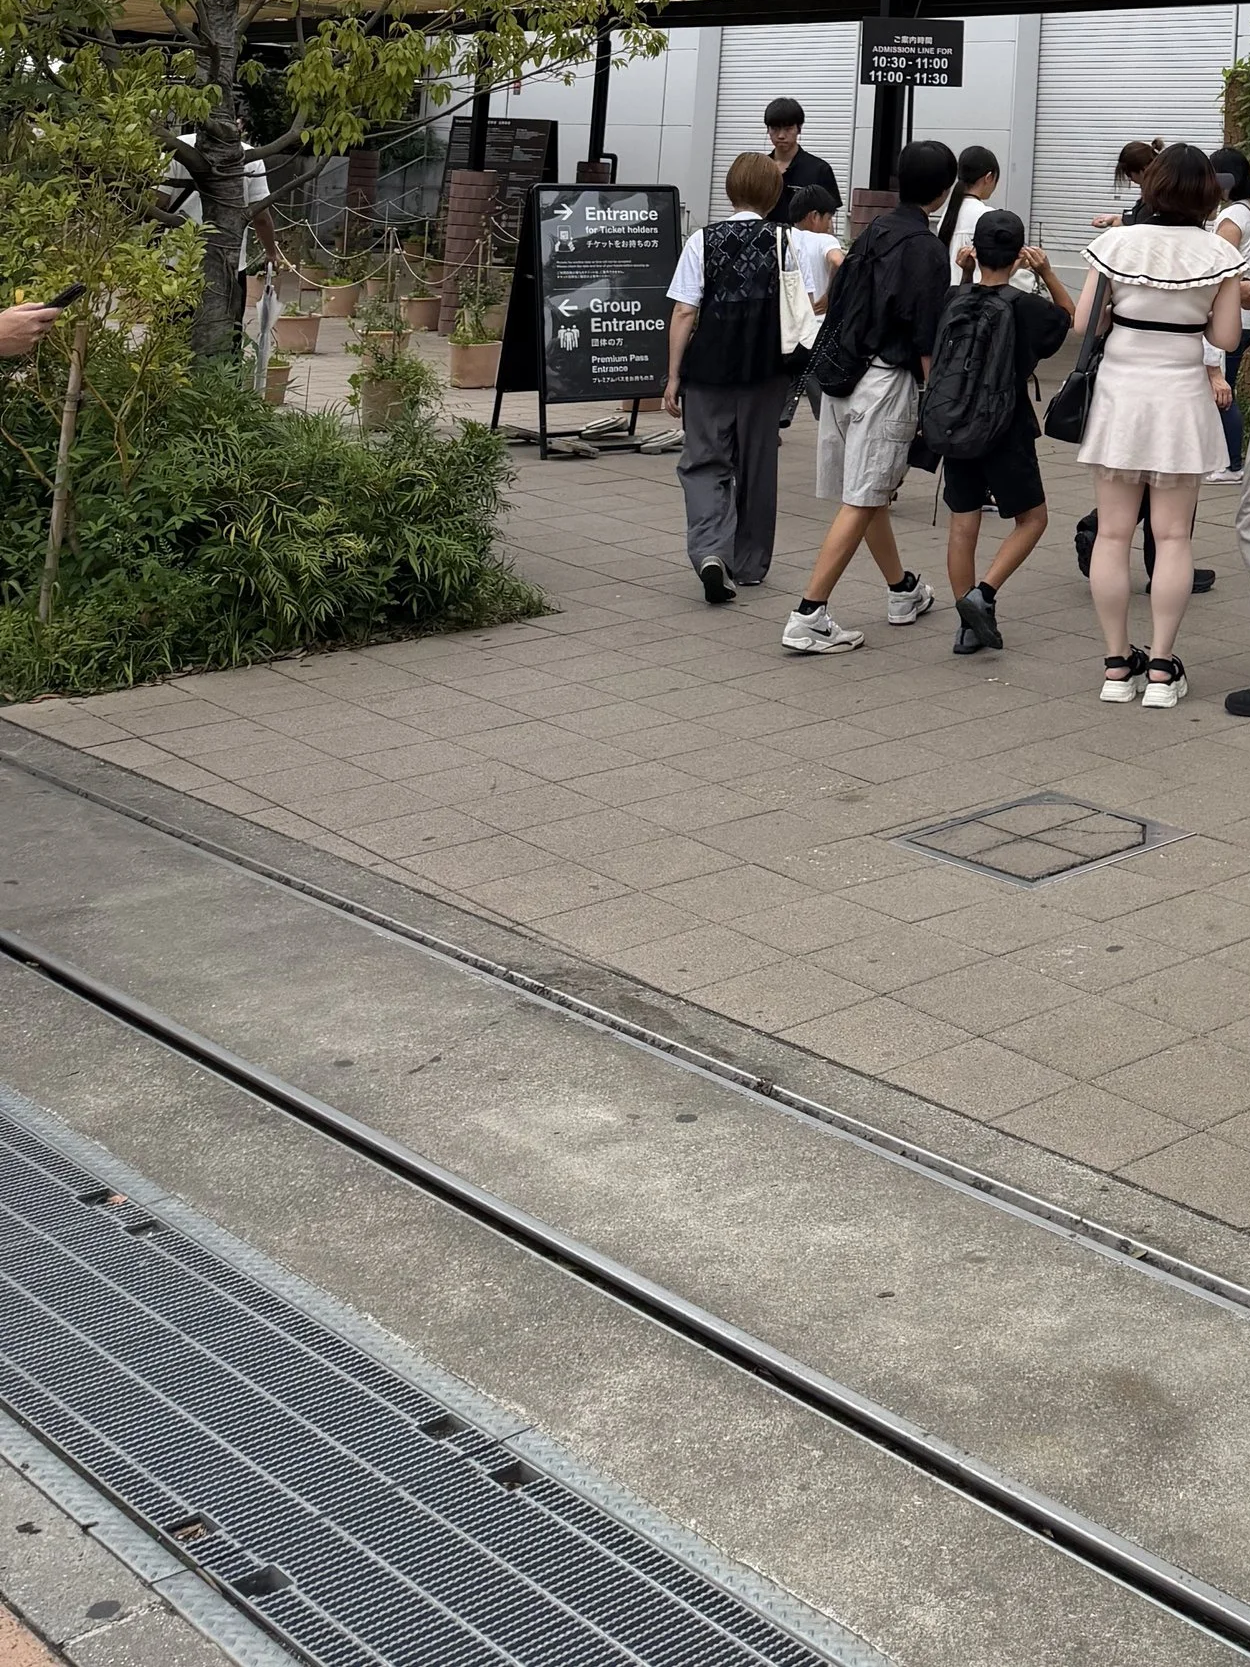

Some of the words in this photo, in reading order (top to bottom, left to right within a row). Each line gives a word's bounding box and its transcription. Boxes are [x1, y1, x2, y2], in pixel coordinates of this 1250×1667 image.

[894, 36, 933, 44] ご案内時間
[872, 46, 915, 54] ADMISSION
[872, 56, 906, 68] 10:30
[915, 58, 948, 69] 11:00
[869, 70, 903, 83] 11:00
[914, 72, 948, 84] 11:30
[585, 207, 658, 221] Entrance
[585, 226, 599, 234] for
[600, 226, 625, 234] Ticket
[627, 226, 658, 234] holders
[586, 240, 659, 248] チケットをお持ちの方
[590, 298, 641, 315] Group
[590, 318, 665, 332] Entrance
[591, 338, 624, 347] 団体の方
[592, 355, 628, 363] Premium
[630, 354, 649, 362] Pass
[592, 365, 628, 373] Entrance
